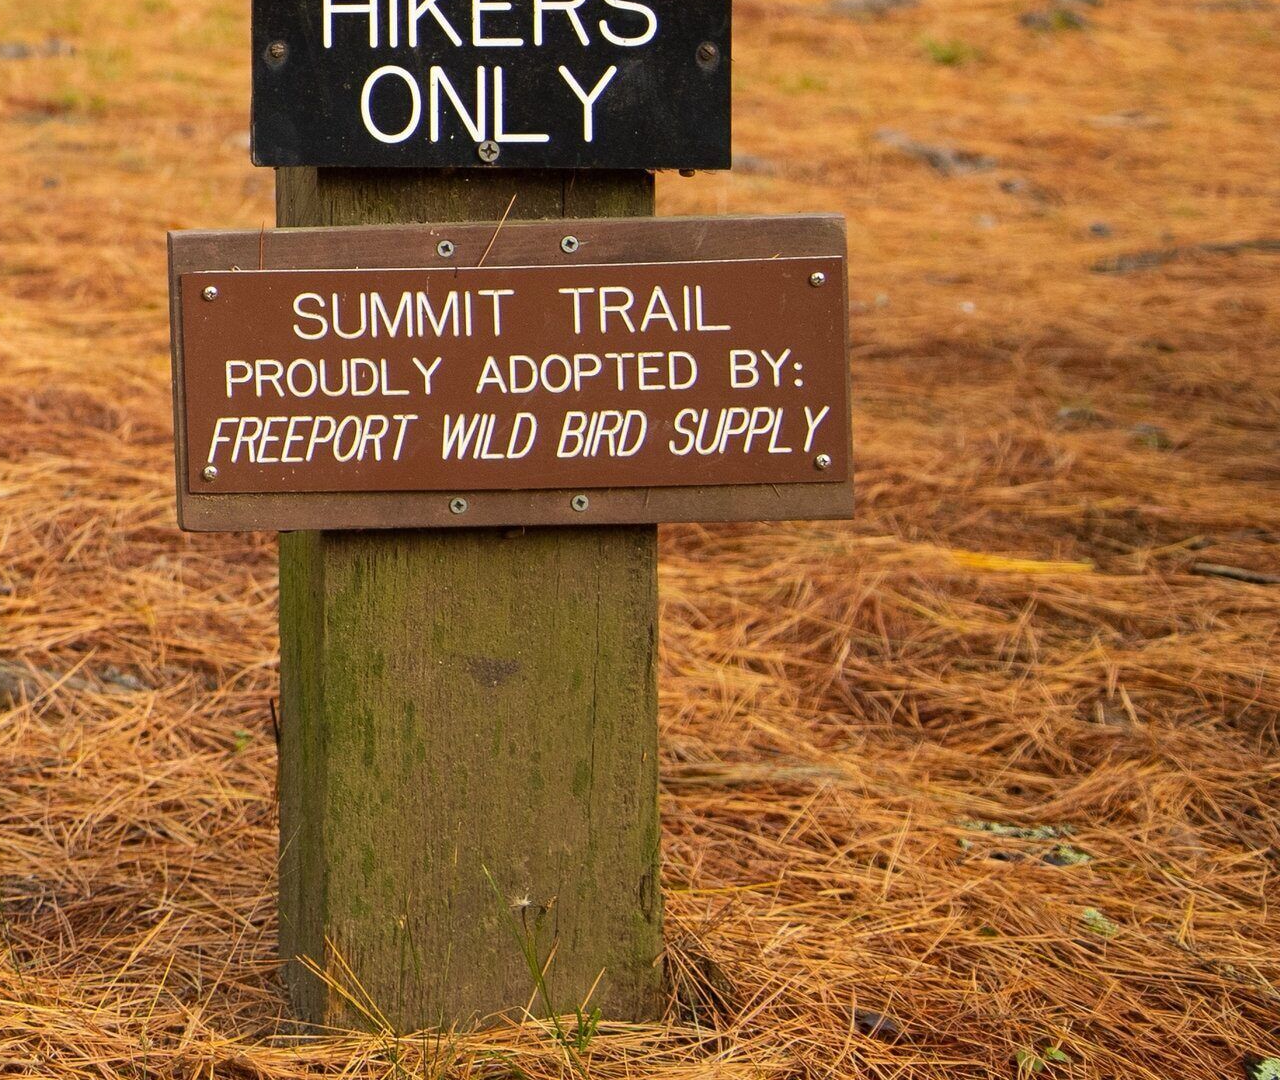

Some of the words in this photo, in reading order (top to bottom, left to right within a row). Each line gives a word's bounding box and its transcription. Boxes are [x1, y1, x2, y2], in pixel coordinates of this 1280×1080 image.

[360, 65, 618, 144] ONLY
[292, 289, 515, 340] SUMMIT
[558, 285, 732, 335] TRAIL
[225, 356, 442, 399] PROUDLY
[475, 351, 698, 394] ADOPTED
[729, 348, 804, 389] BY:
[207, 414, 419, 464] FREEPORT
[441, 412, 538, 460] WILD
[556, 409, 648, 458] BIRD
[668, 405, 830, 456] SUPPLY
